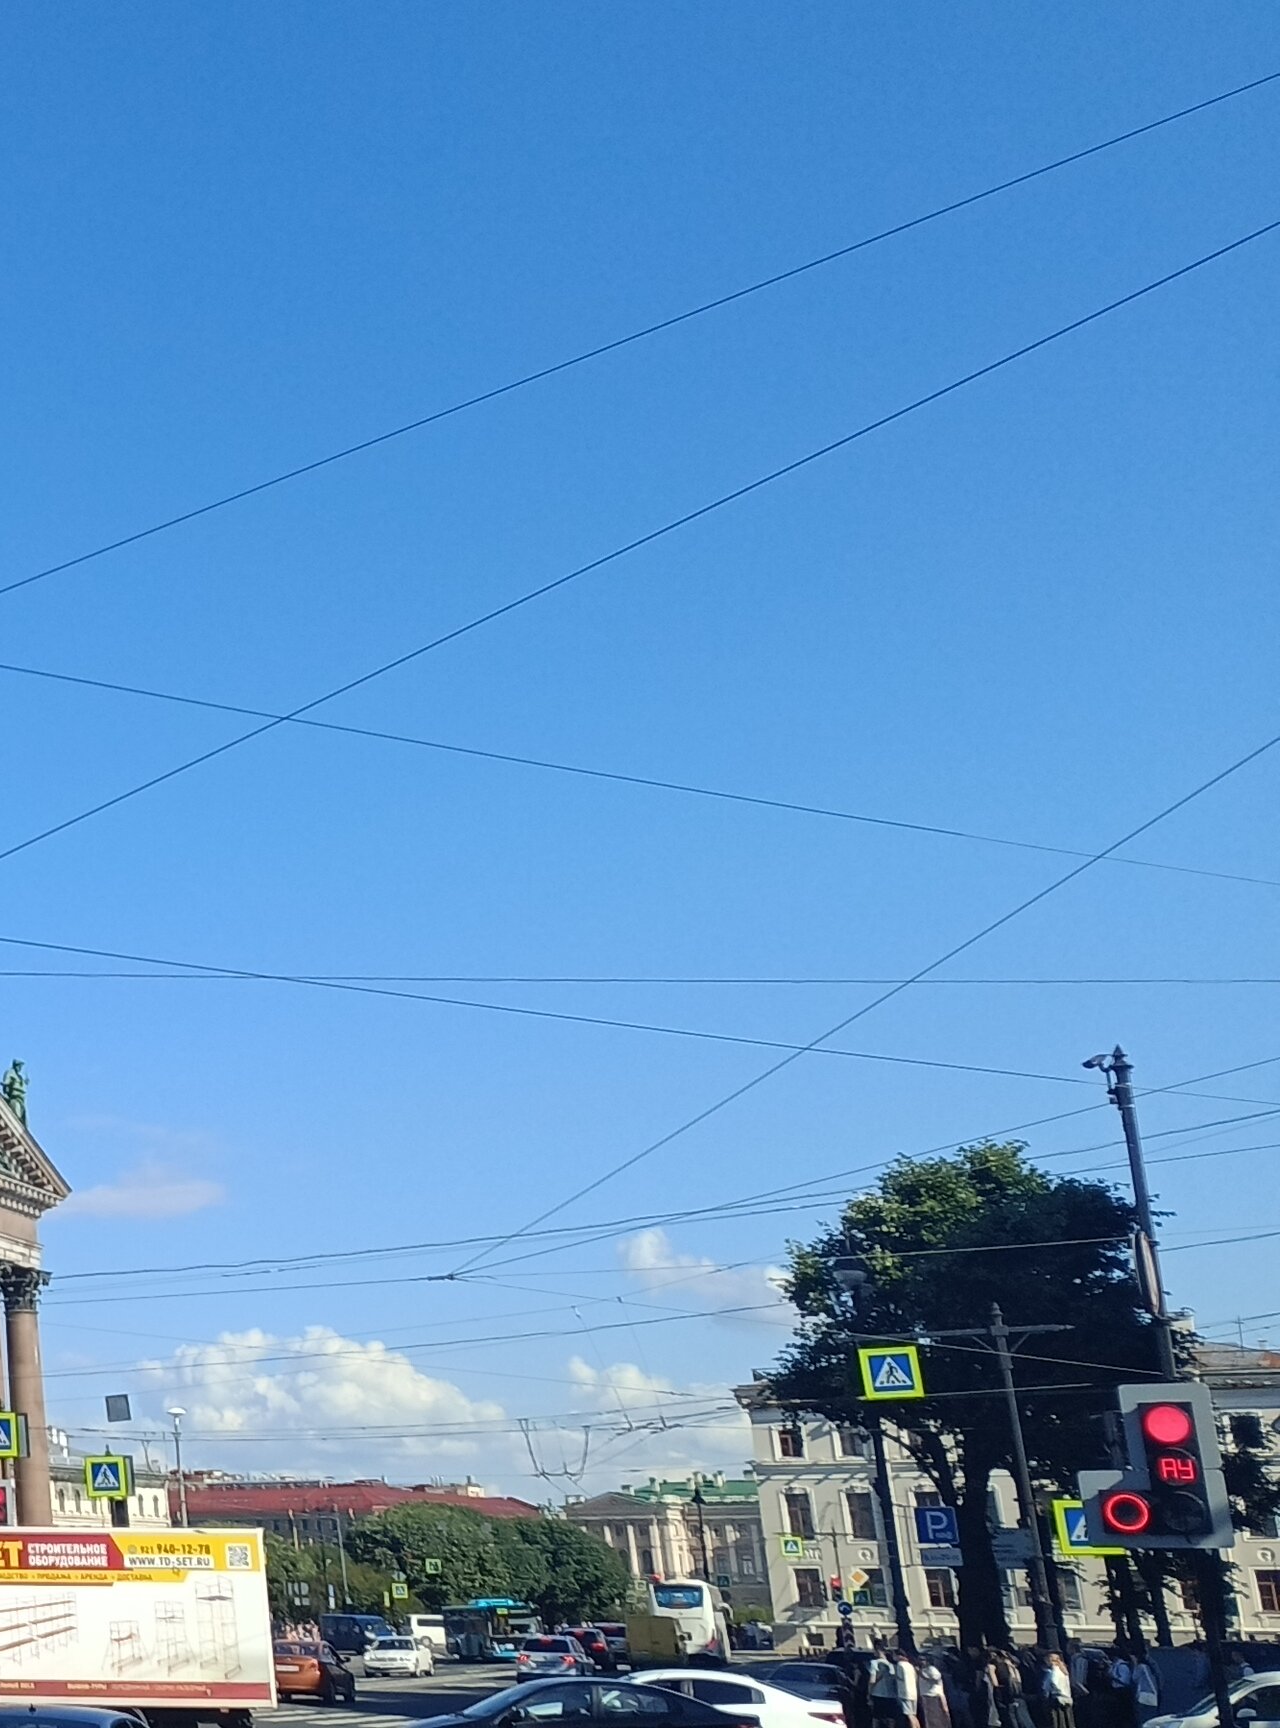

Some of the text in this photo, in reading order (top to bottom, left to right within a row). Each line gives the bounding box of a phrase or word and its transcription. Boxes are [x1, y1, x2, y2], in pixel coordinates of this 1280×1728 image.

[925, 1510, 949, 1540] P
[27, 1542, 108, 1556] СТРОИТЕЛЬНОЕ
[156, 1543, 211, 1555] 940-12-78
[28, 1555, 109, 1568] ОБОРУДОВАНИЕ
[128, 1556, 210, 1567] WWW.TD-SET.RU
